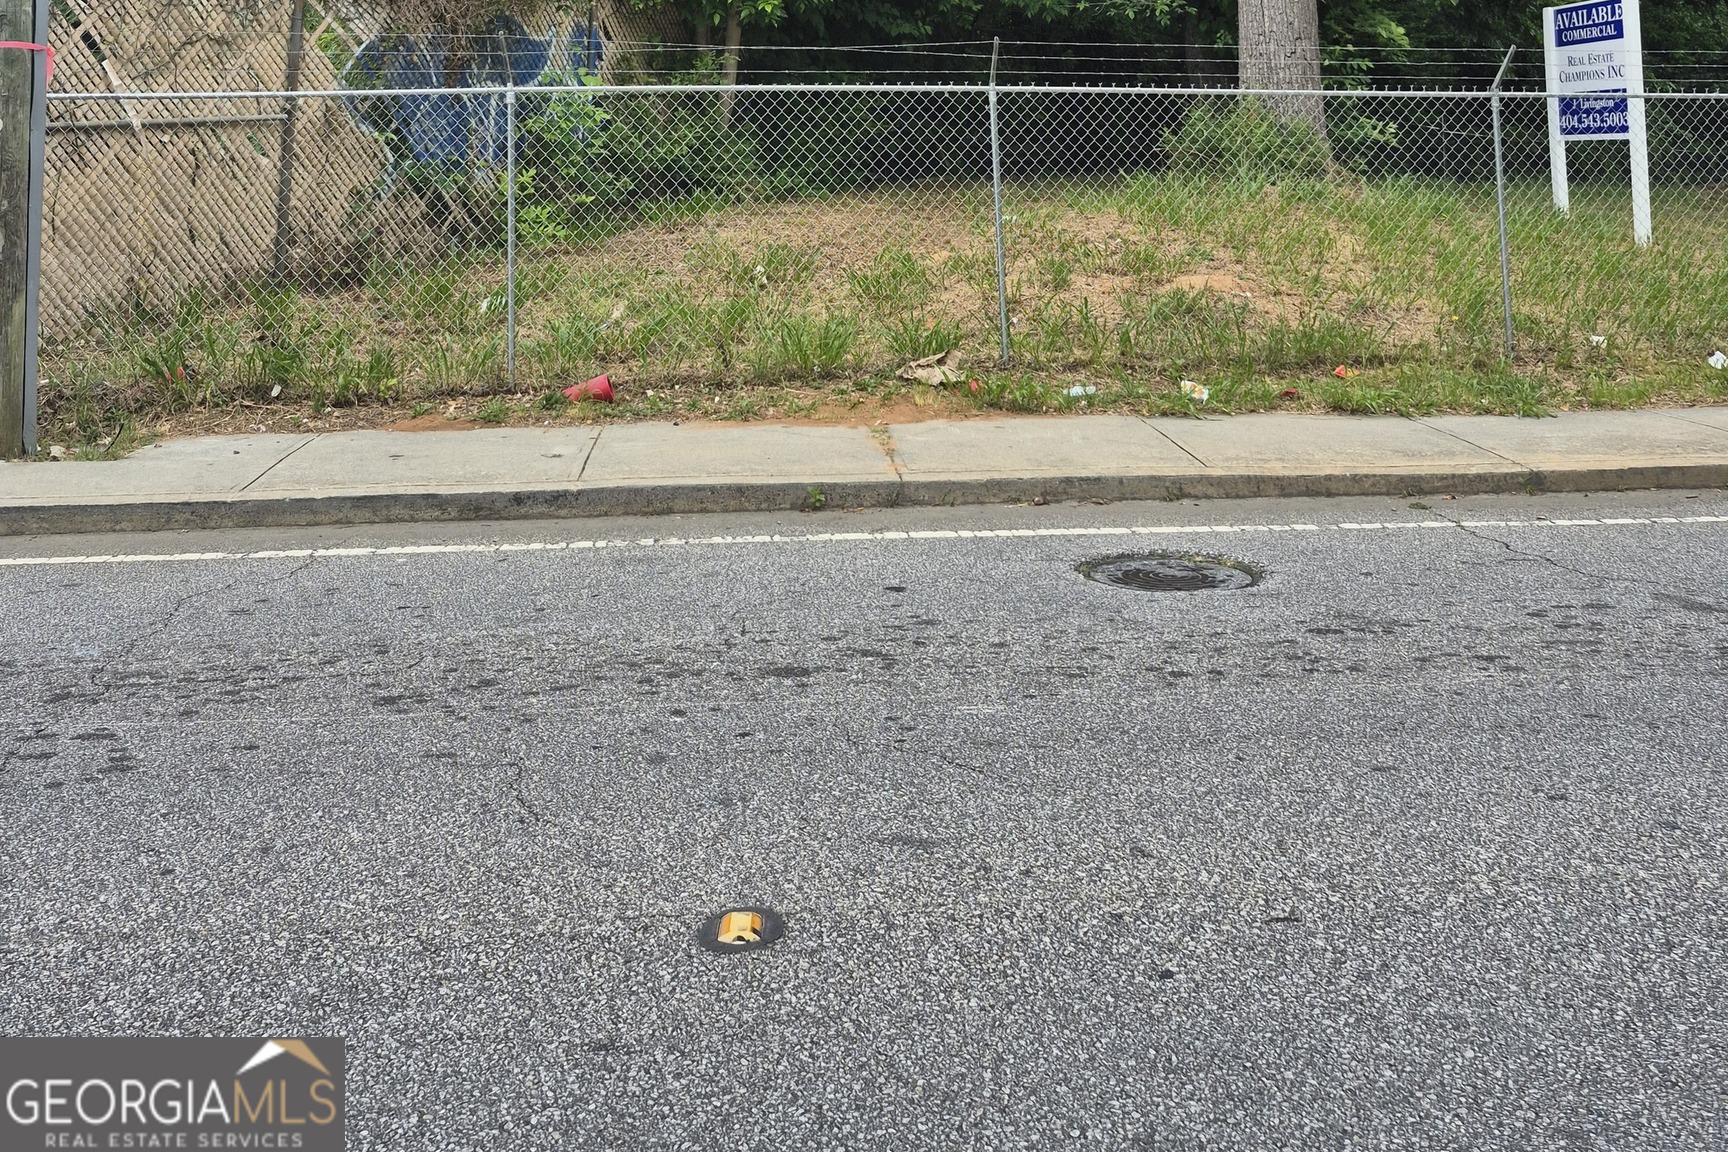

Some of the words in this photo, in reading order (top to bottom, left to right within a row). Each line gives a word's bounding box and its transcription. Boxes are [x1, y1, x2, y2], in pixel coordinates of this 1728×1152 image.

[1556, 3, 1623, 30] AVAILABLE
[1562, 24, 1617, 42] COMMERCIAL
[1608, 65, 1625, 78] INC
[1560, 112, 1628, 128] 404.543.5003
